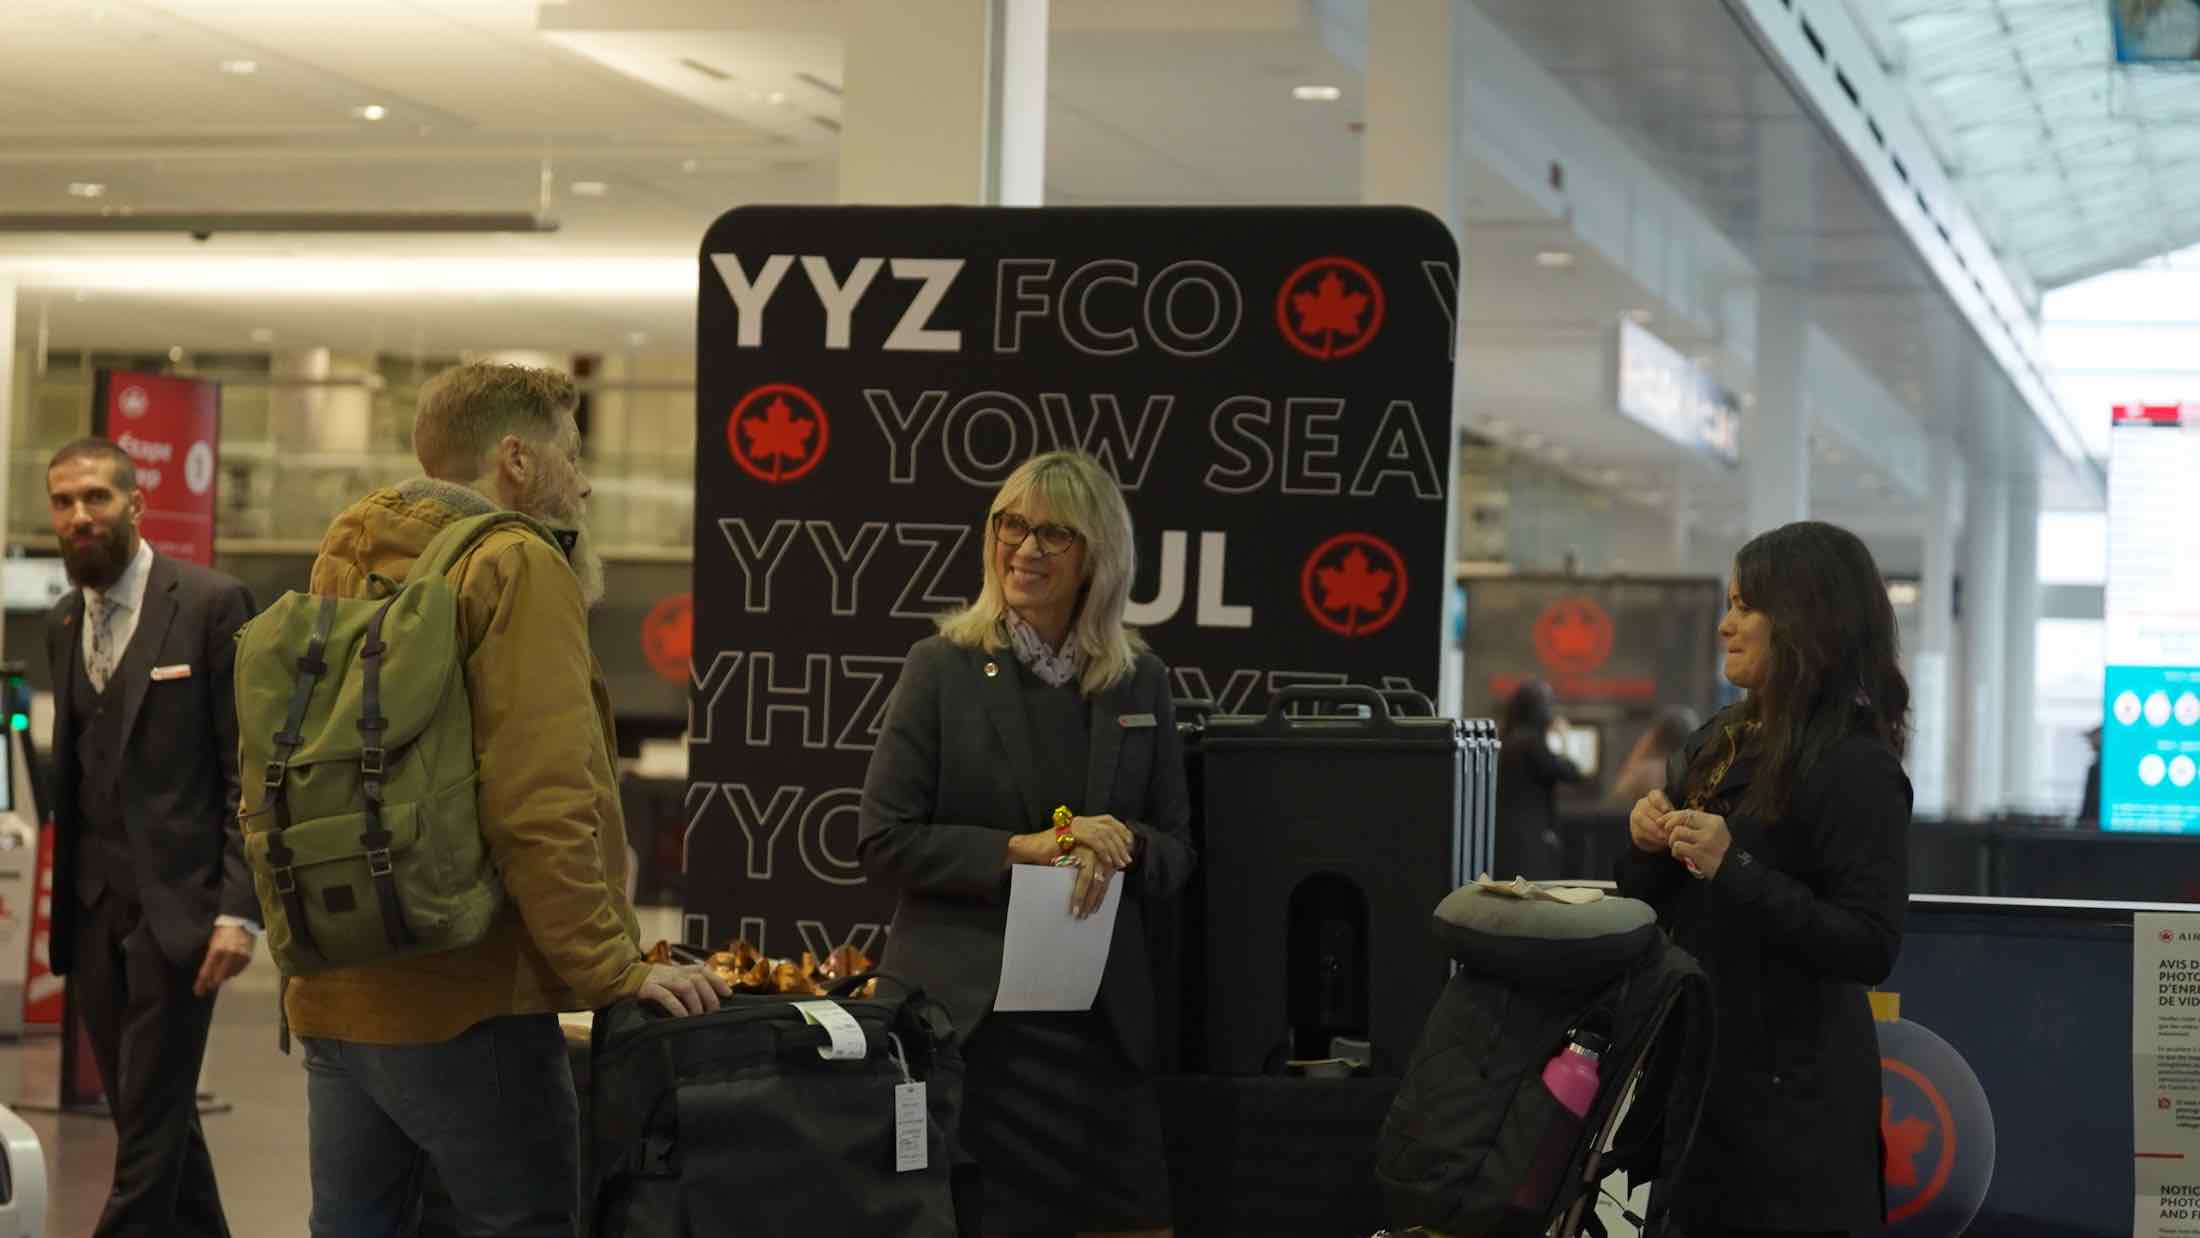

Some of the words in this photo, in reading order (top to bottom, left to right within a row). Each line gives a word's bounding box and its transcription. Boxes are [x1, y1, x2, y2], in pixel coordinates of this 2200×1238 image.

[709, 253, 967, 352] YYZ
[994, 258, 1243, 357] FCO
[862, 388, 1175, 492] YOW
[1203, 395, 1443, 499] SEA
[718, 518, 971, 619] YYZ
[1122, 530, 1253, 628] UL
[688, 651, 907, 750] YHZ
[2160, 960, 2187, 969] AVIS
[2160, 996, 2176, 1006] DE
[2160, 1210, 2188, 1219] AND
